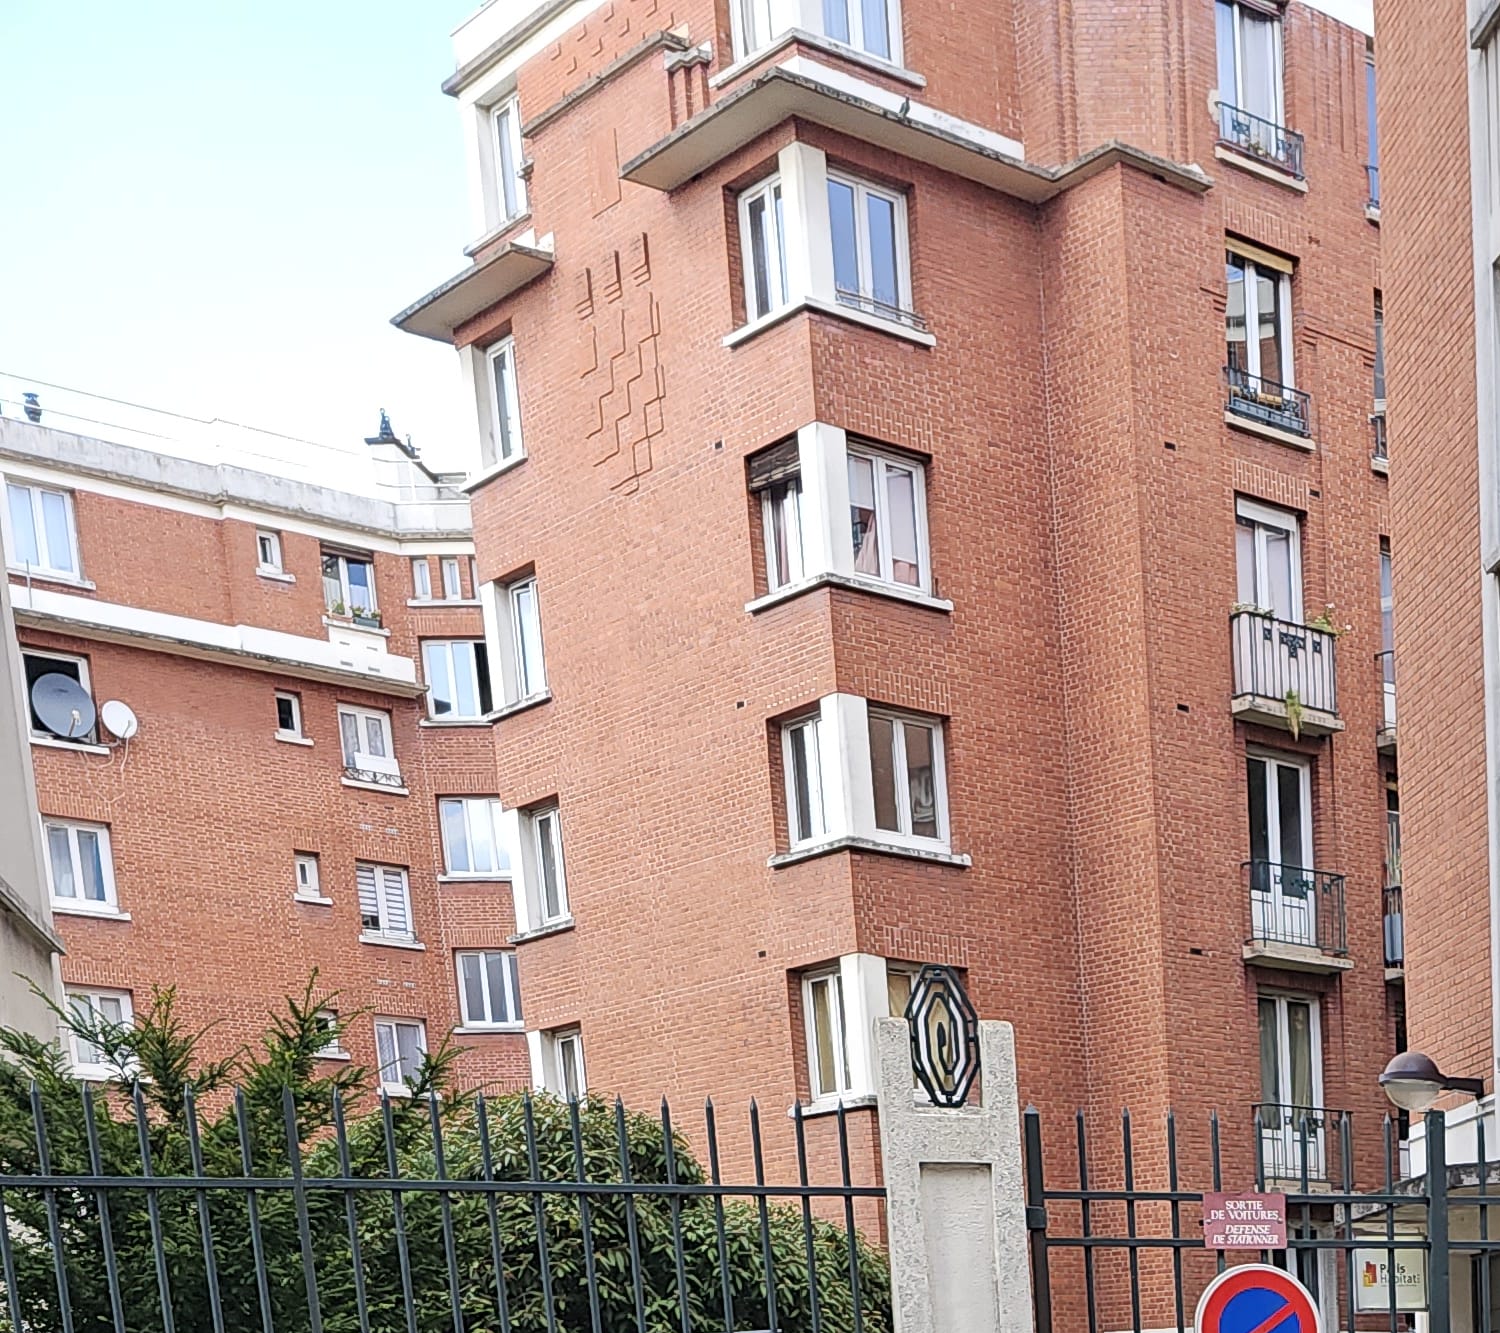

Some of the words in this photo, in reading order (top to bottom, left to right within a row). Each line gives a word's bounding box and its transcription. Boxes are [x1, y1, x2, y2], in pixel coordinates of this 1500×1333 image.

[1225, 1200, 1263, 1210] SORTIE
[1210, 1210, 1225, 1220] DE
[1227, 1210, 1279, 1220] VOITURES
[1213, 1234, 1225, 1244] DE
[1226, 1234, 1279, 1244] STATIONNER
[1380, 1263, 1406, 1274] Pis
